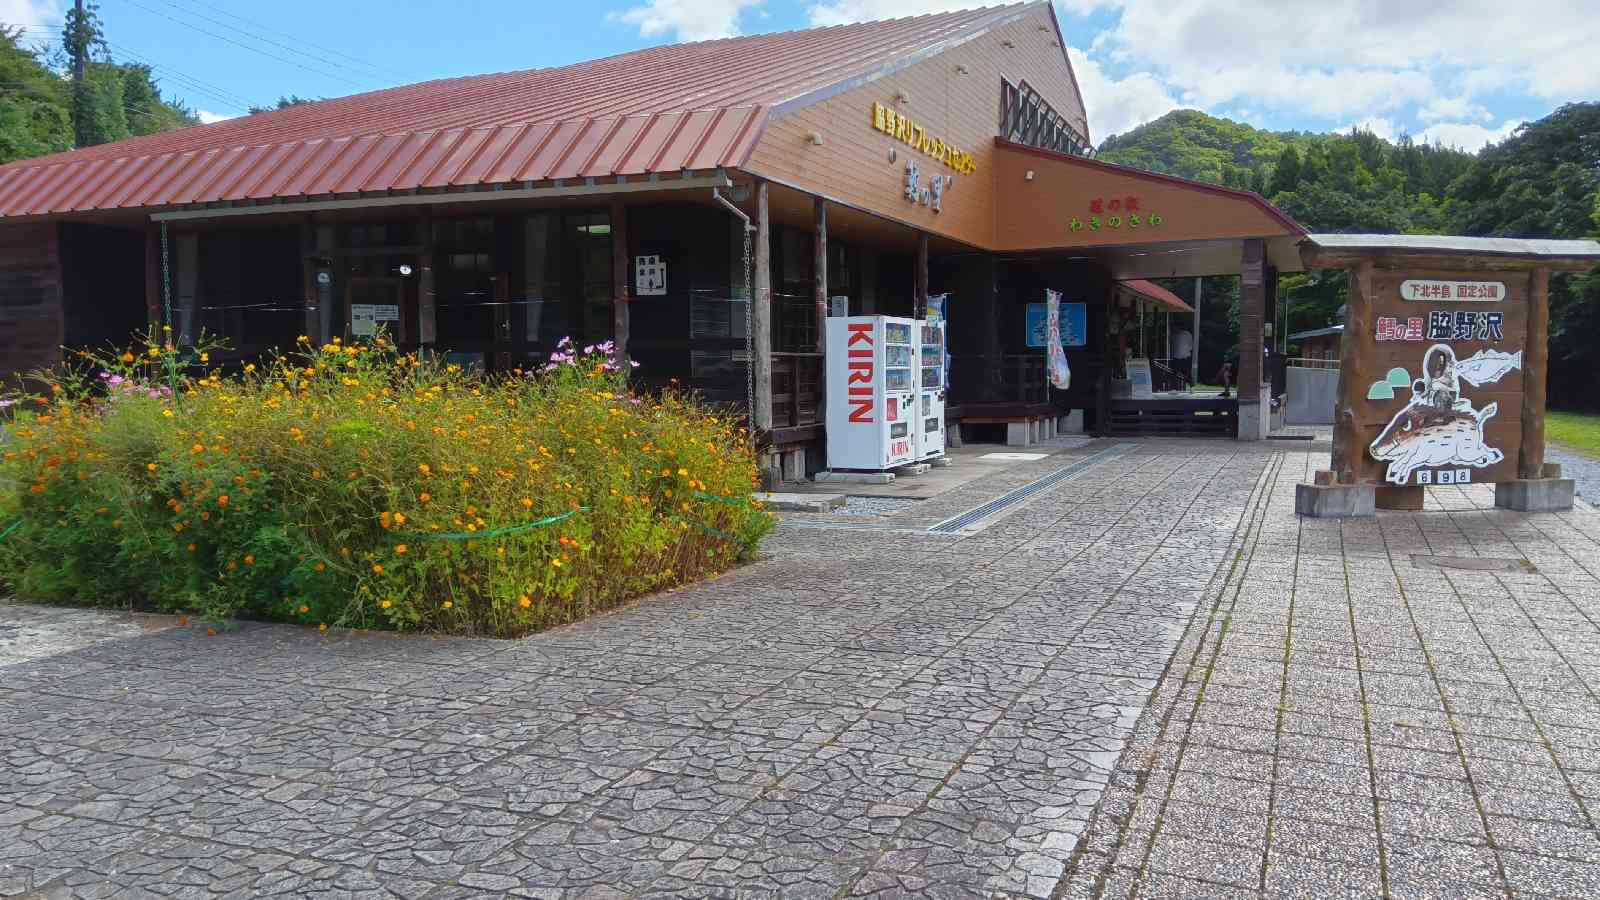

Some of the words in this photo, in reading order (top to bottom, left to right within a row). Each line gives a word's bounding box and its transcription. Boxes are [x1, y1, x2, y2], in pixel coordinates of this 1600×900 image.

[1069, 213, 1163, 232] わきのさわ
[1409, 284, 1451, 298] 下北半島
[1457, 284, 1498, 298] 国定公園
[1427, 311, 1504, 340] 脇野沢
[847, 323, 874, 423] KIRIN
[891, 440, 909, 457] KIRIN
